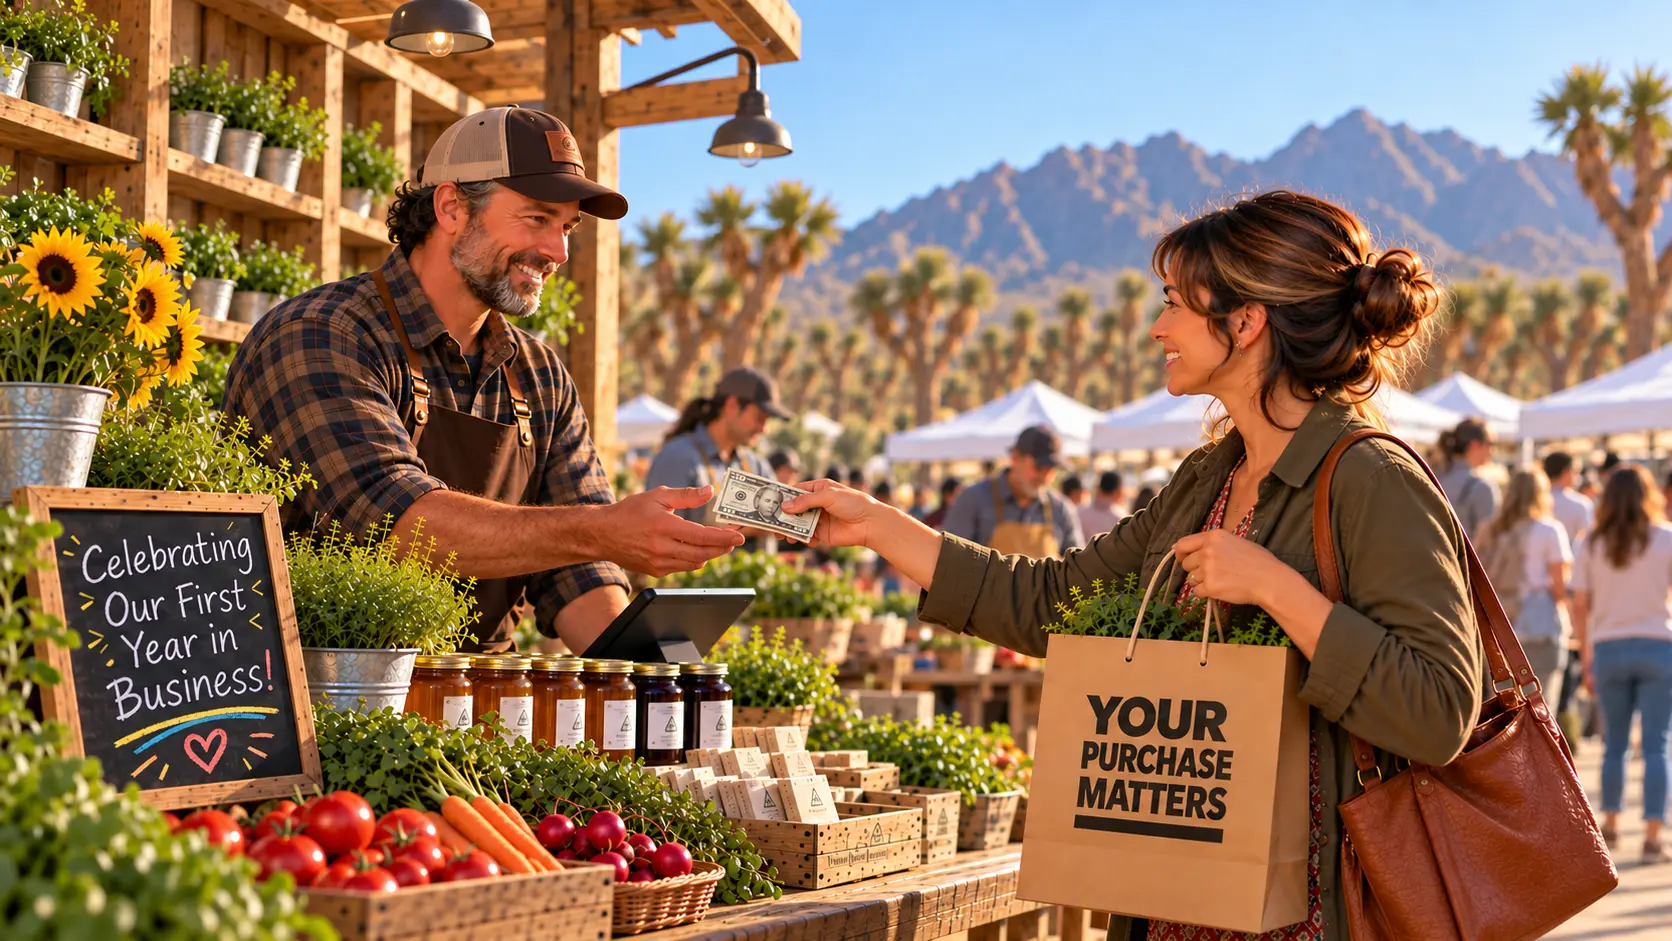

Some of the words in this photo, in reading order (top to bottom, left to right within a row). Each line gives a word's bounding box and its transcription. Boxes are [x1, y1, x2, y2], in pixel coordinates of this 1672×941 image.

[81, 532, 253, 584] Celebrating
[104, 590, 164, 627] Our
[175, 579, 246, 618] First
[120, 630, 198, 668] Year
[208, 623, 238, 654] in
[106, 648, 273, 722] Business!
[1086, 694, 1228, 742] YOUR
[1080, 740, 1234, 781] PURCHASE
[1076, 776, 1228, 821] MATTERS
